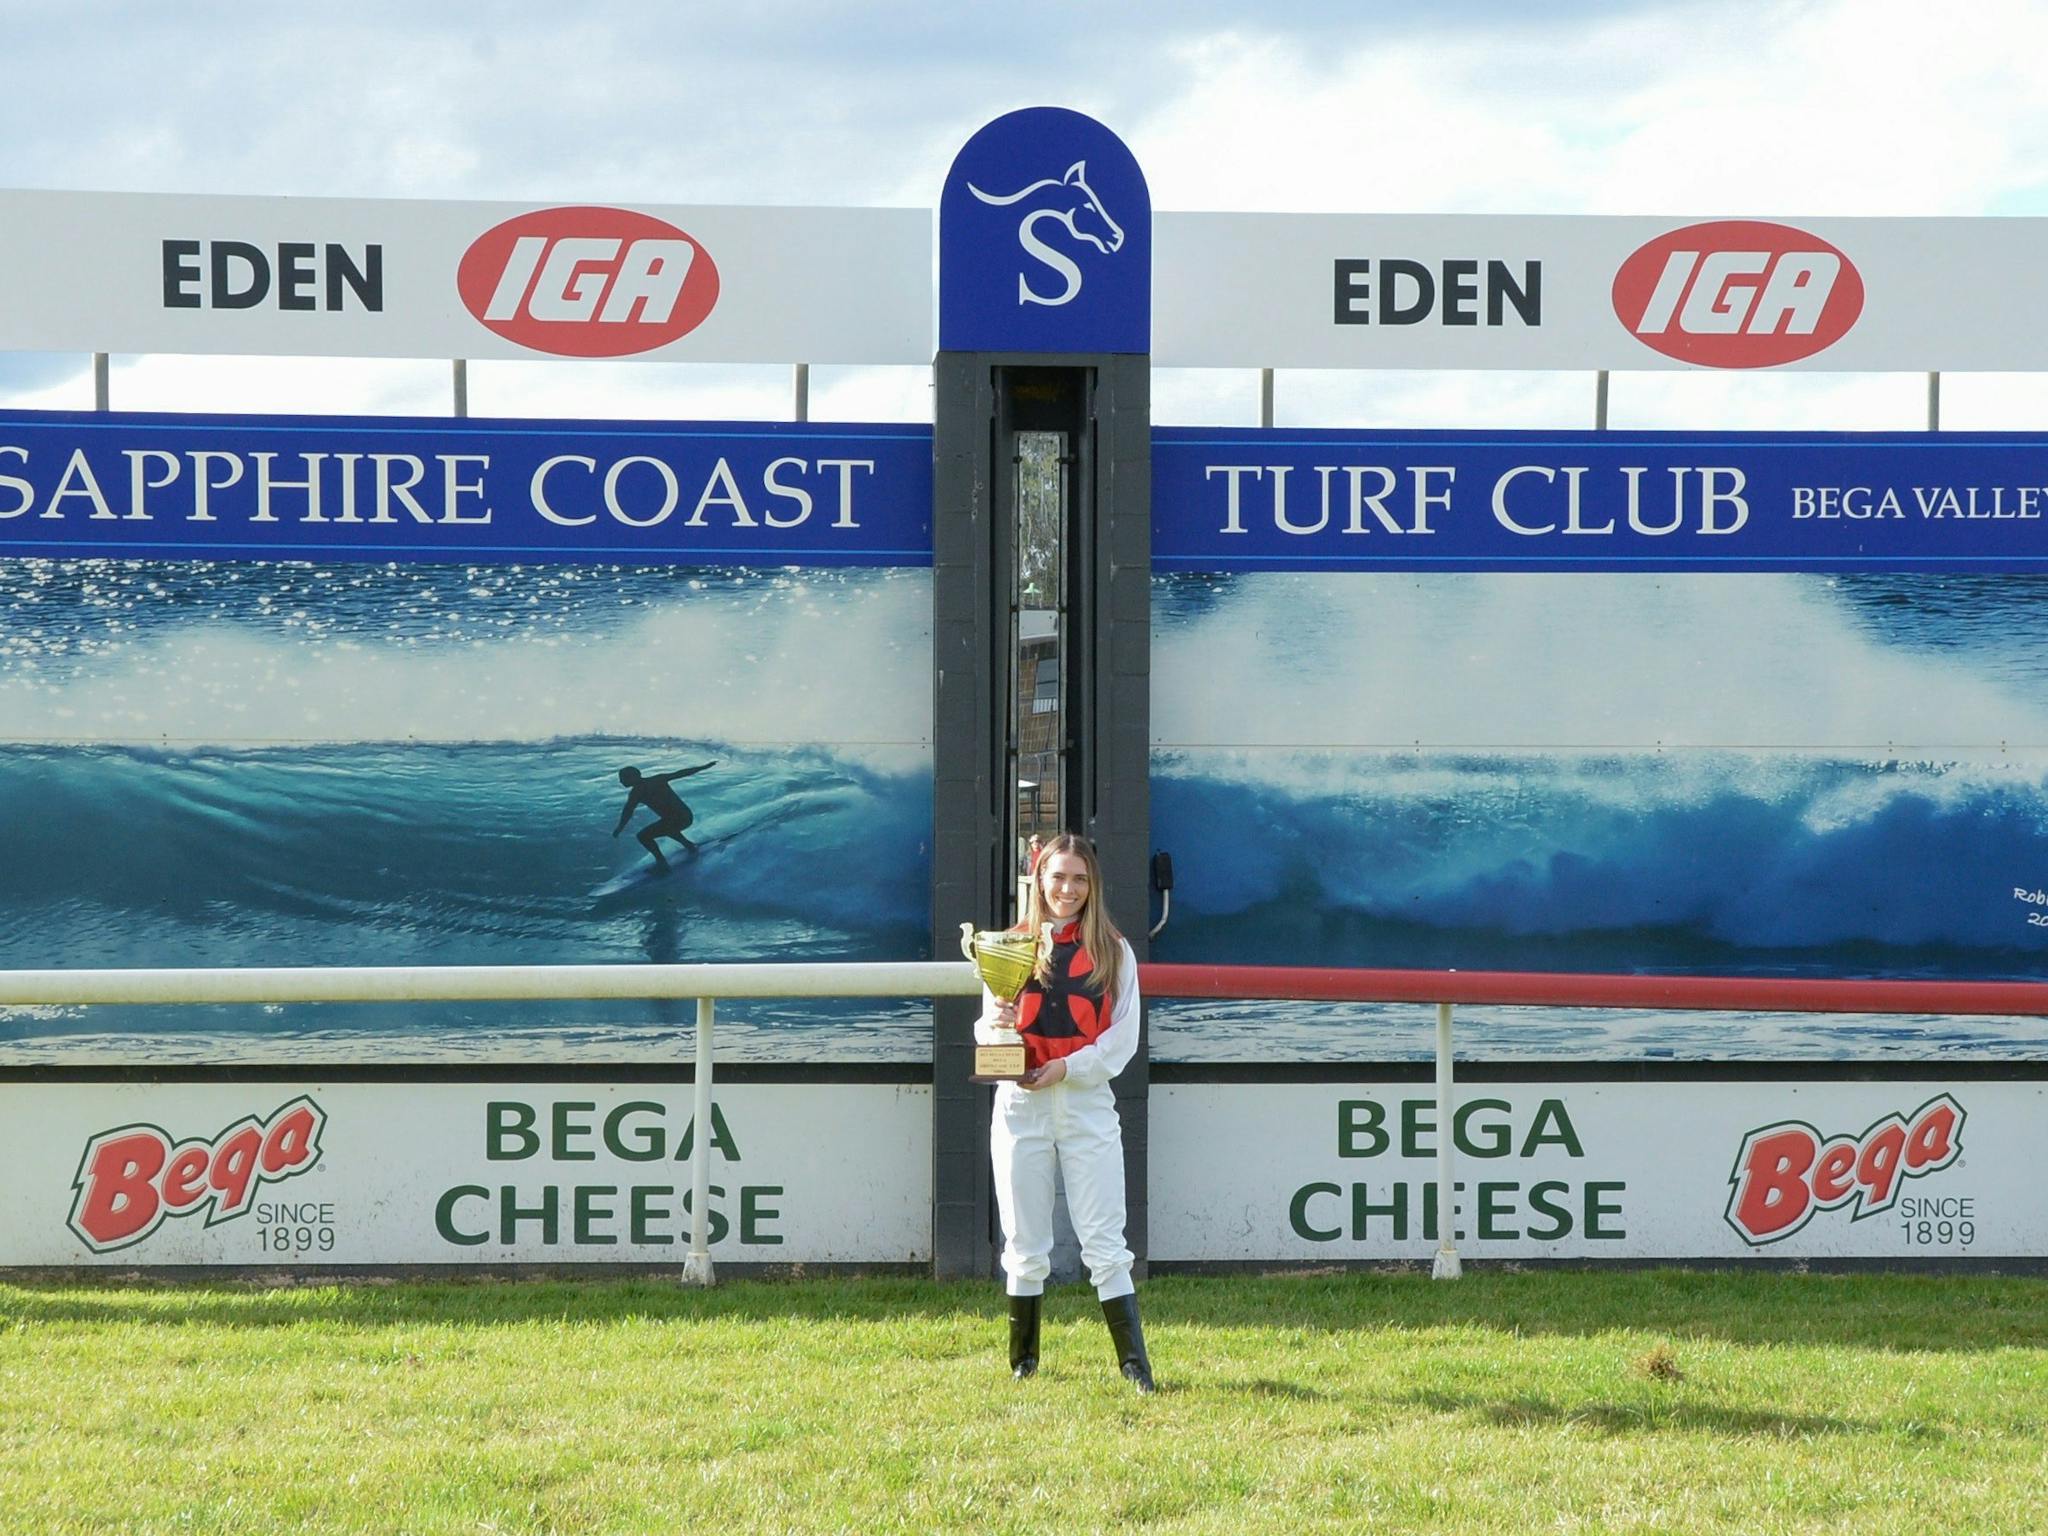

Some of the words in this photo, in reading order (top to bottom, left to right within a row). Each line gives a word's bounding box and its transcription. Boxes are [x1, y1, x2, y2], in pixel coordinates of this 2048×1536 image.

[162, 239, 383, 312] EDEN
[483, 236, 695, 324] IGA
[1334, 259, 1542, 327] EDEN
[1637, 251, 1842, 335] IGA
[0, 446, 492, 524] SAPPHIRE
[530, 454, 875, 528] COAST
[1205, 465, 1456, 535] TURF
[1491, 465, 1749, 536] CLUB
[1792, 487, 1905, 519] BEGA
[486, 1100, 742, 1162] BEGA
[1338, 1098, 1585, 1159] BEGA
[77, 1102, 316, 1244] Bega
[1735, 1101, 1956, 1238] Bega
[256, 1202, 335, 1225] SINCE
[256, 1227, 335, 1252] 1899
[434, 1184, 784, 1249] CHEESE
[1288, 1180, 1627, 1243] CHEESE
[1900, 1197, 1975, 1219] SINCE
[1901, 1221, 1975, 1246] 1899
